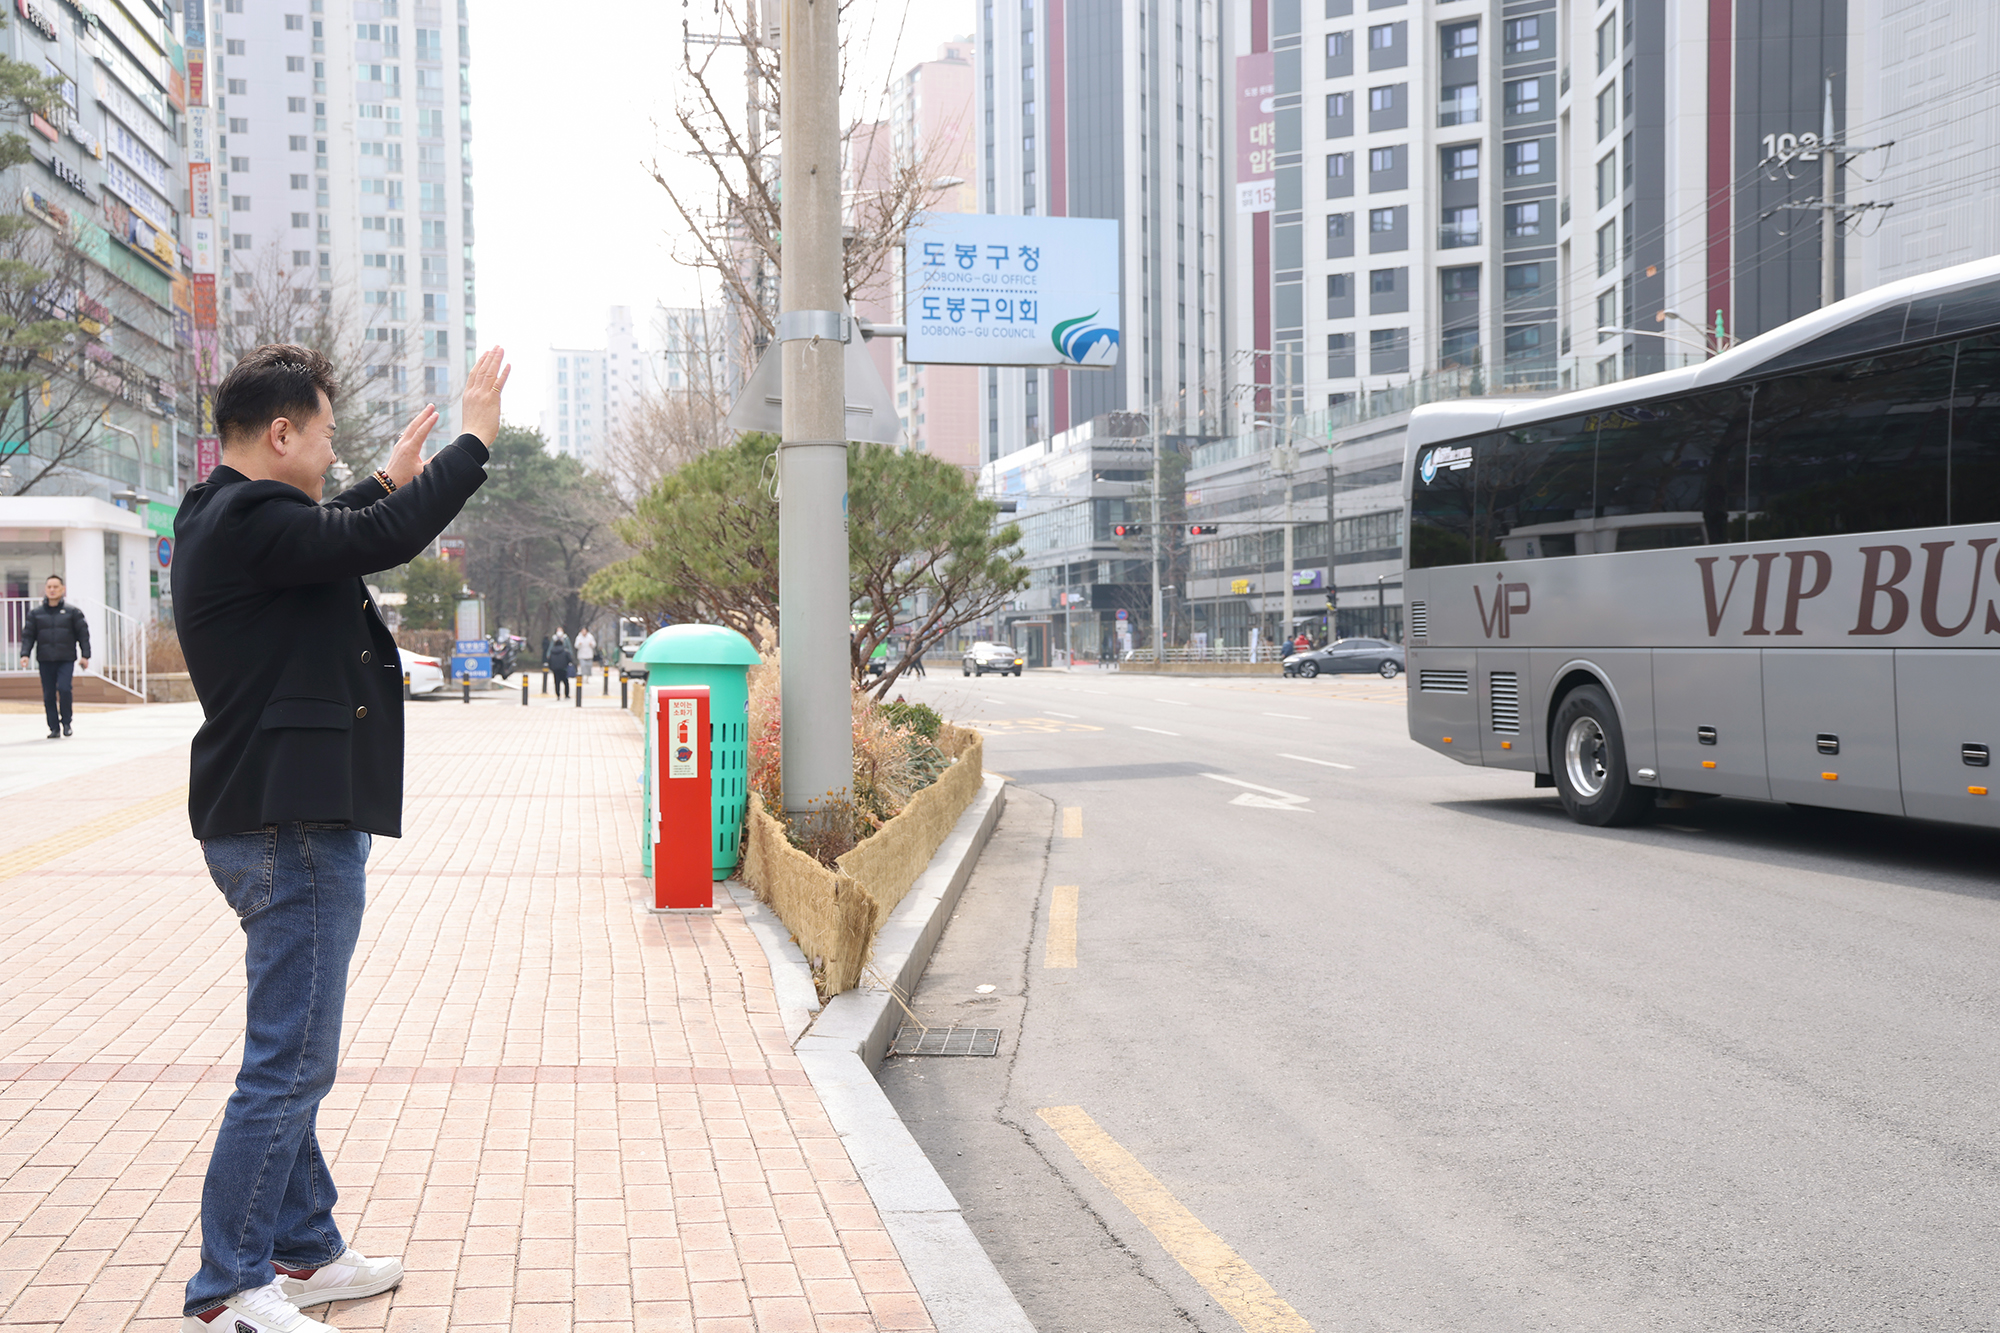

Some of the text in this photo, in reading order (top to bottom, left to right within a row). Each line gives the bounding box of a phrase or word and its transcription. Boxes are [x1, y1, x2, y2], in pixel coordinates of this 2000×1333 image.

[1762, 132, 1819, 161] 102
[1255, 188, 1275, 205] 15
[922, 242, 1040, 272] 도봉구청
[924, 271, 1038, 286] DOBONG-GU OFFICE
[921, 296, 1038, 325] 도봉구의회
[921, 325, 1036, 339] DOBONG-GU COUNCIL
[1695, 537, 2000, 637] VIP BU
[1473, 571, 1531, 639] VIP
[673, 701, 693, 709] 보이는
